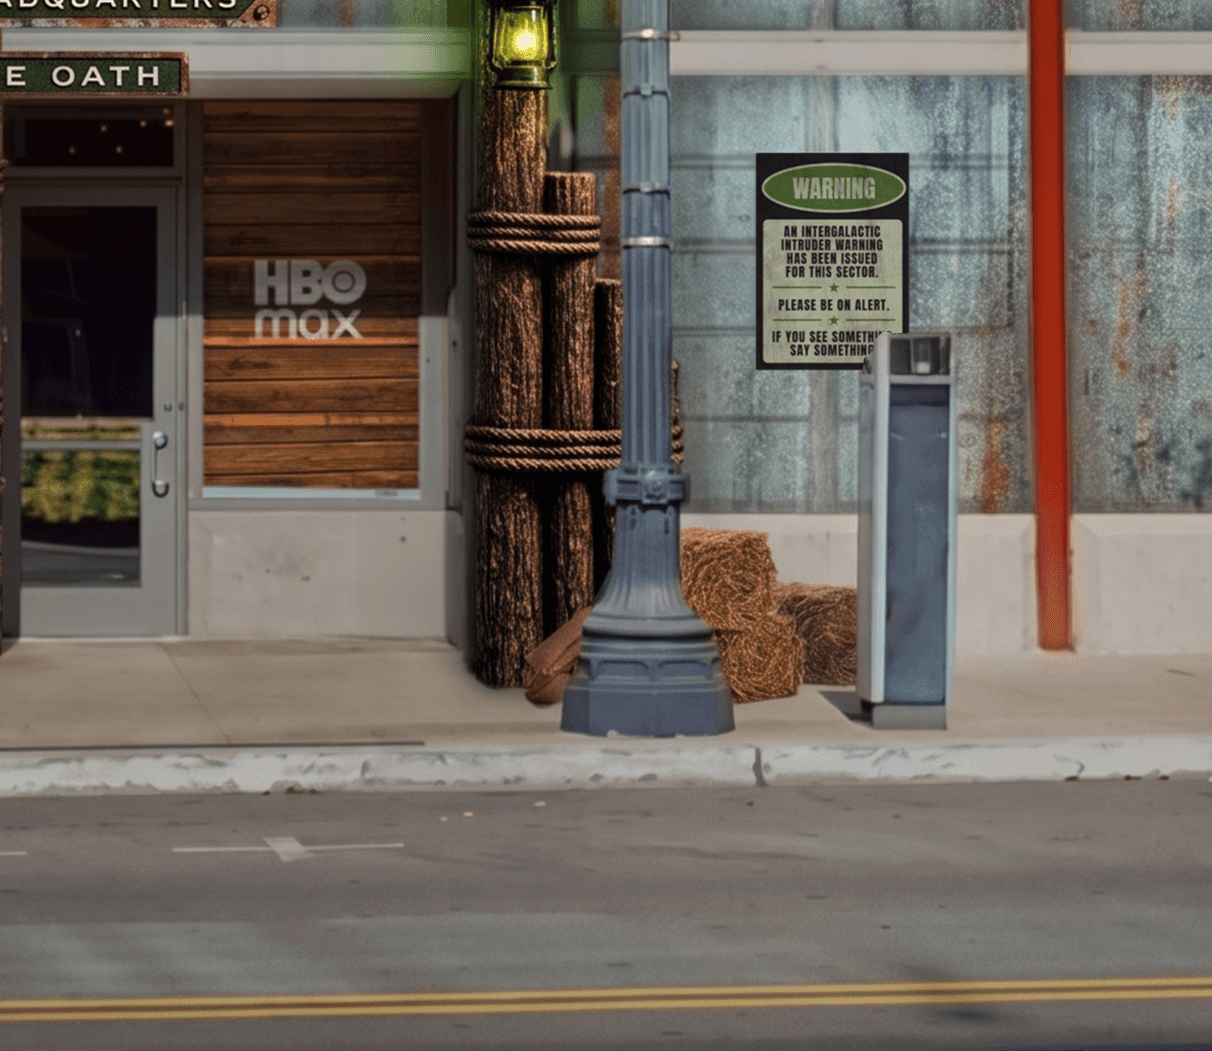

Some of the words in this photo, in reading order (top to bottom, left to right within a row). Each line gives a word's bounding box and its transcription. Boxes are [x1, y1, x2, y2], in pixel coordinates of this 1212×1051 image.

[51, 65, 160, 87] OATH
[792, 176, 876, 200] WARNING
[783, 225, 798, 238] AN
[801, 225, 881, 238] INTERGALACTIC
[781, 238, 832, 251] INTRUDER
[835, 238, 883, 251] WARNING
[786, 252, 808, 265] HAS
[811, 252, 837, 265] BEEN
[840, 252, 878, 265] ISSUED
[785, 265, 805, 278] FOR
[808, 265, 832, 278] THIS
[836, 265, 879, 278] SECTOR.
[254, 259, 367, 305] HBO
[778, 298, 817, 311] PLEASE
[820, 298, 833, 311] BE
[837, 298, 851, 311] ON
[854, 298, 890, 311] ALERT.
[254, 308, 365, 340] max
[772, 330, 782, 343] IF
[785, 330, 806, 343] YOU
[809, 330, 829, 343] SEE
[789, 344, 810, 357] SAY
